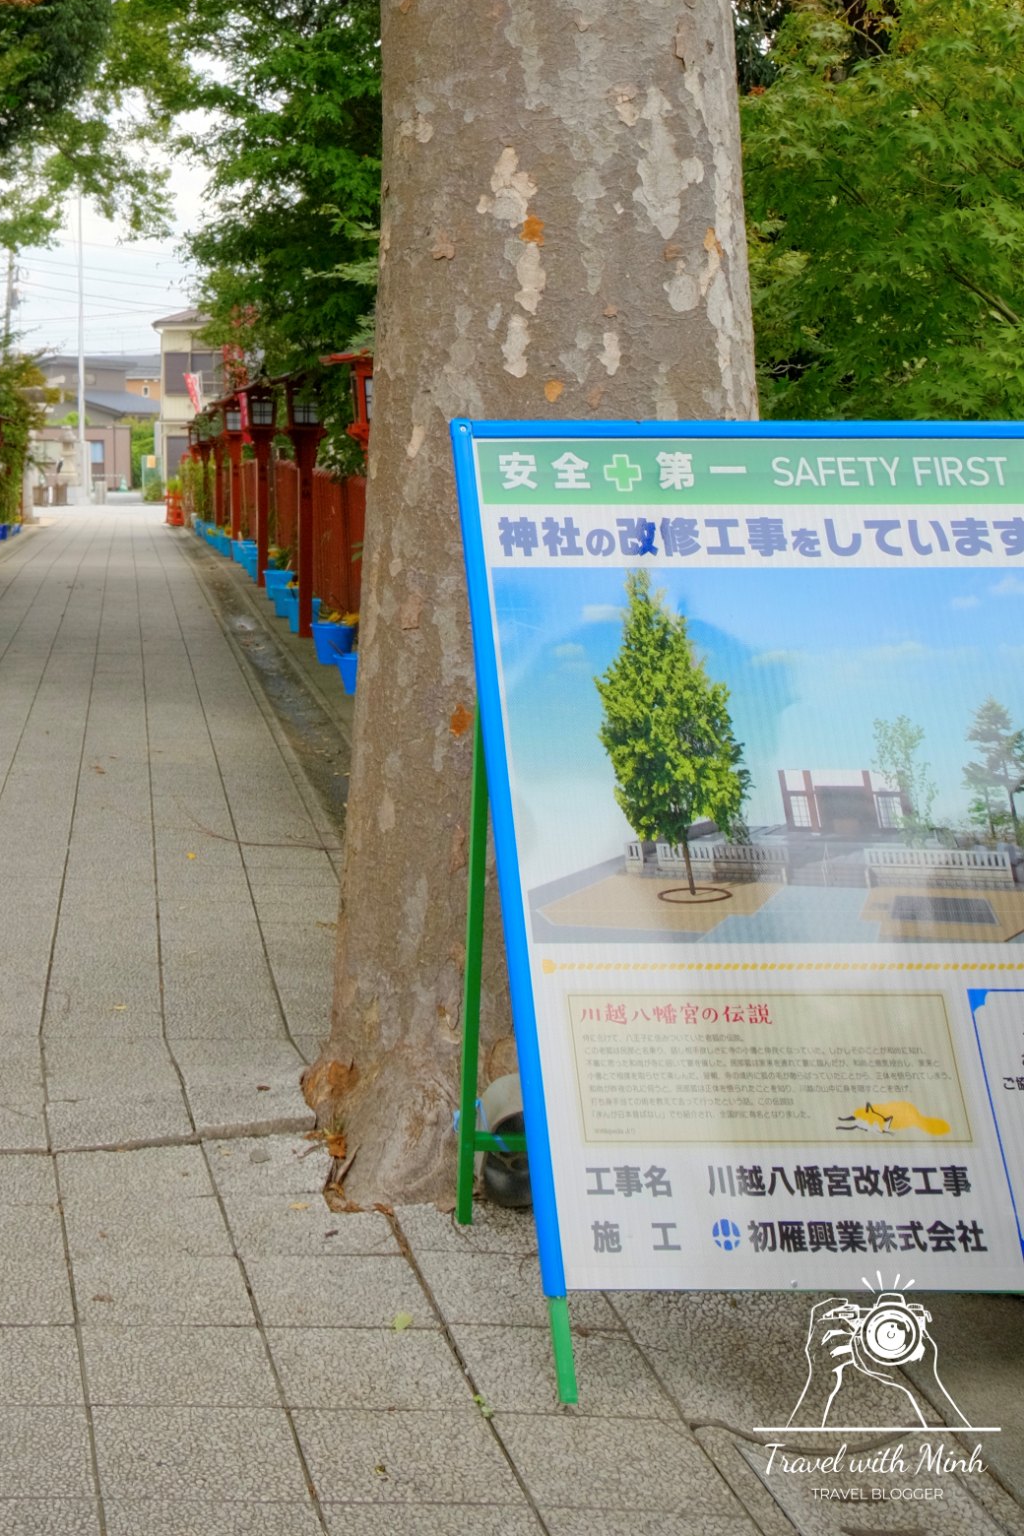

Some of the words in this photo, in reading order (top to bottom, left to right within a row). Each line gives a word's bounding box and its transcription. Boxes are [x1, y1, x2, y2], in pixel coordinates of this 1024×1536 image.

[771, 455, 900, 489] SAFETY
[914, 455, 1008, 488] FIRST
[580, 1002, 774, 1026] 川越八幡宮の伝説
[585, 1164, 673, 1199] 工事名
[708, 1164, 972, 1199] 川越八幡宮改修工事
[747, 1219, 988, 1255] 初雁興業株式会社
